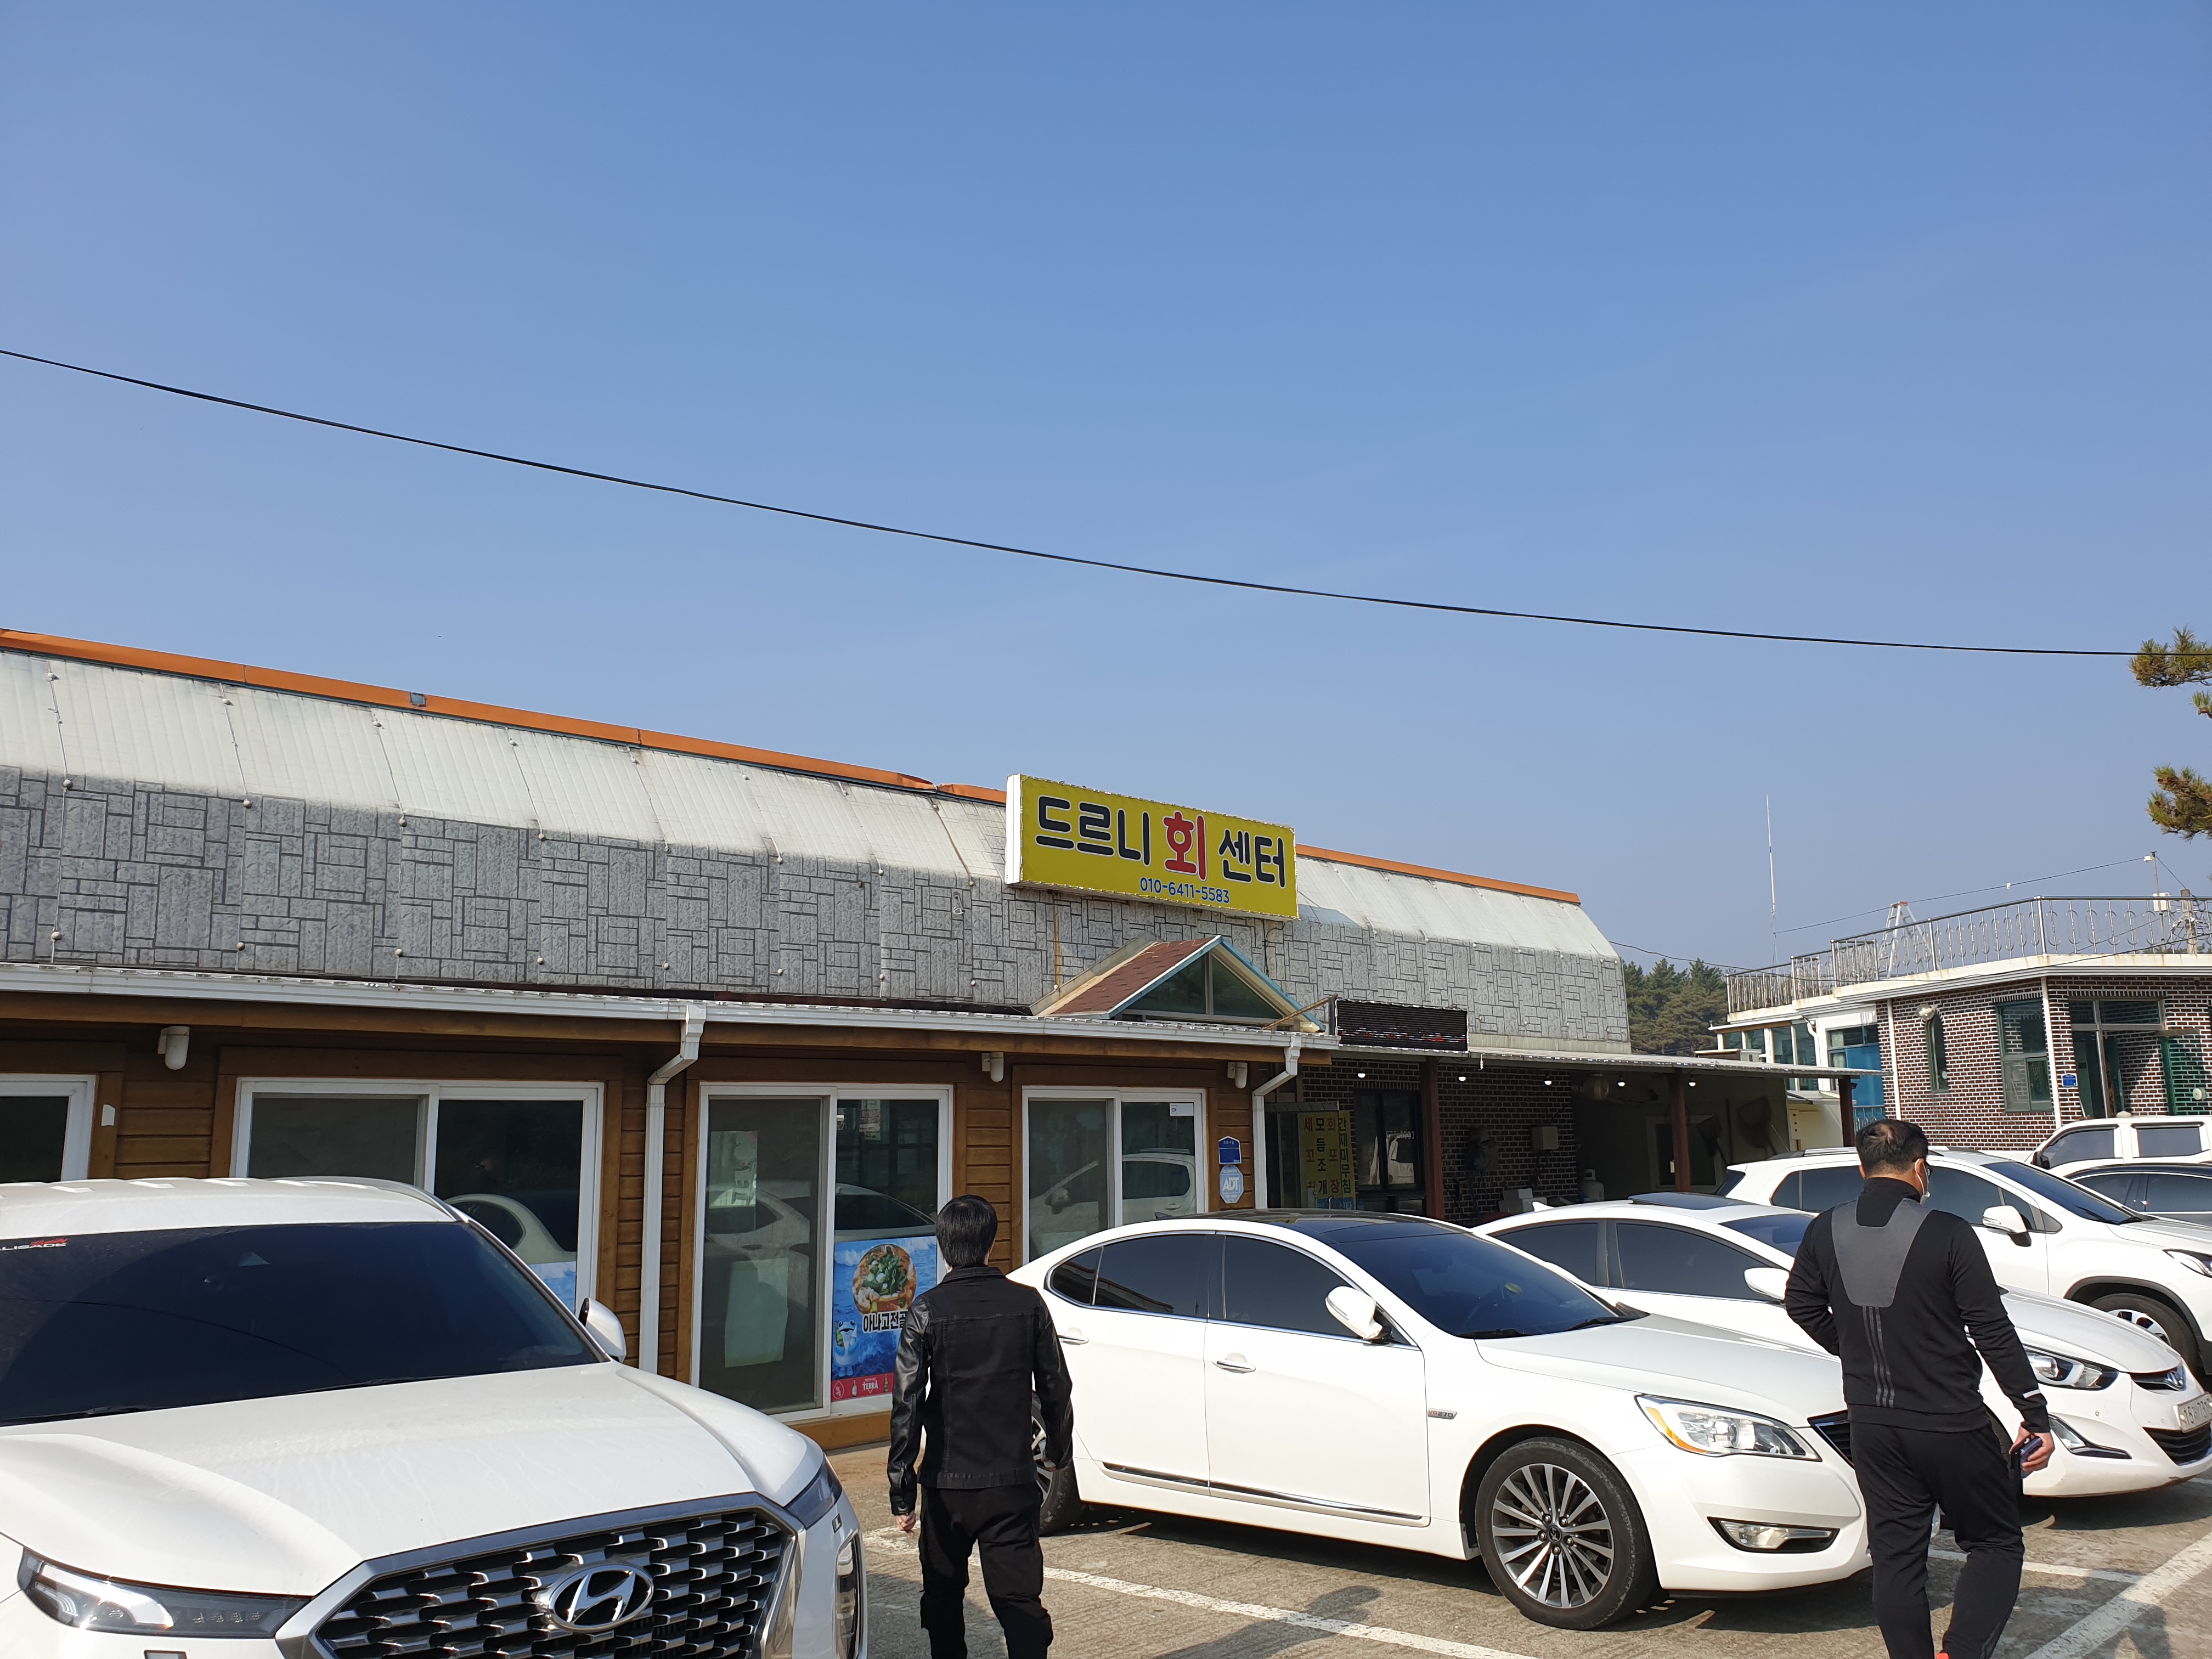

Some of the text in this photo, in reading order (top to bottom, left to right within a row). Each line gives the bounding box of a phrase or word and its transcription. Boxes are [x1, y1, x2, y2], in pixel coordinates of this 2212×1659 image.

[1036, 795, 1286, 889] 드르니 회 센터
[1139, 877, 1230, 904] 010-6411-5583
[1316, 1118, 1327, 1194] 모듬조개
[1222, 1177, 1239, 1192] ADT
[0, 1242, 67, 1251] LISADE
[862, 1379, 878, 1391] TERRA
